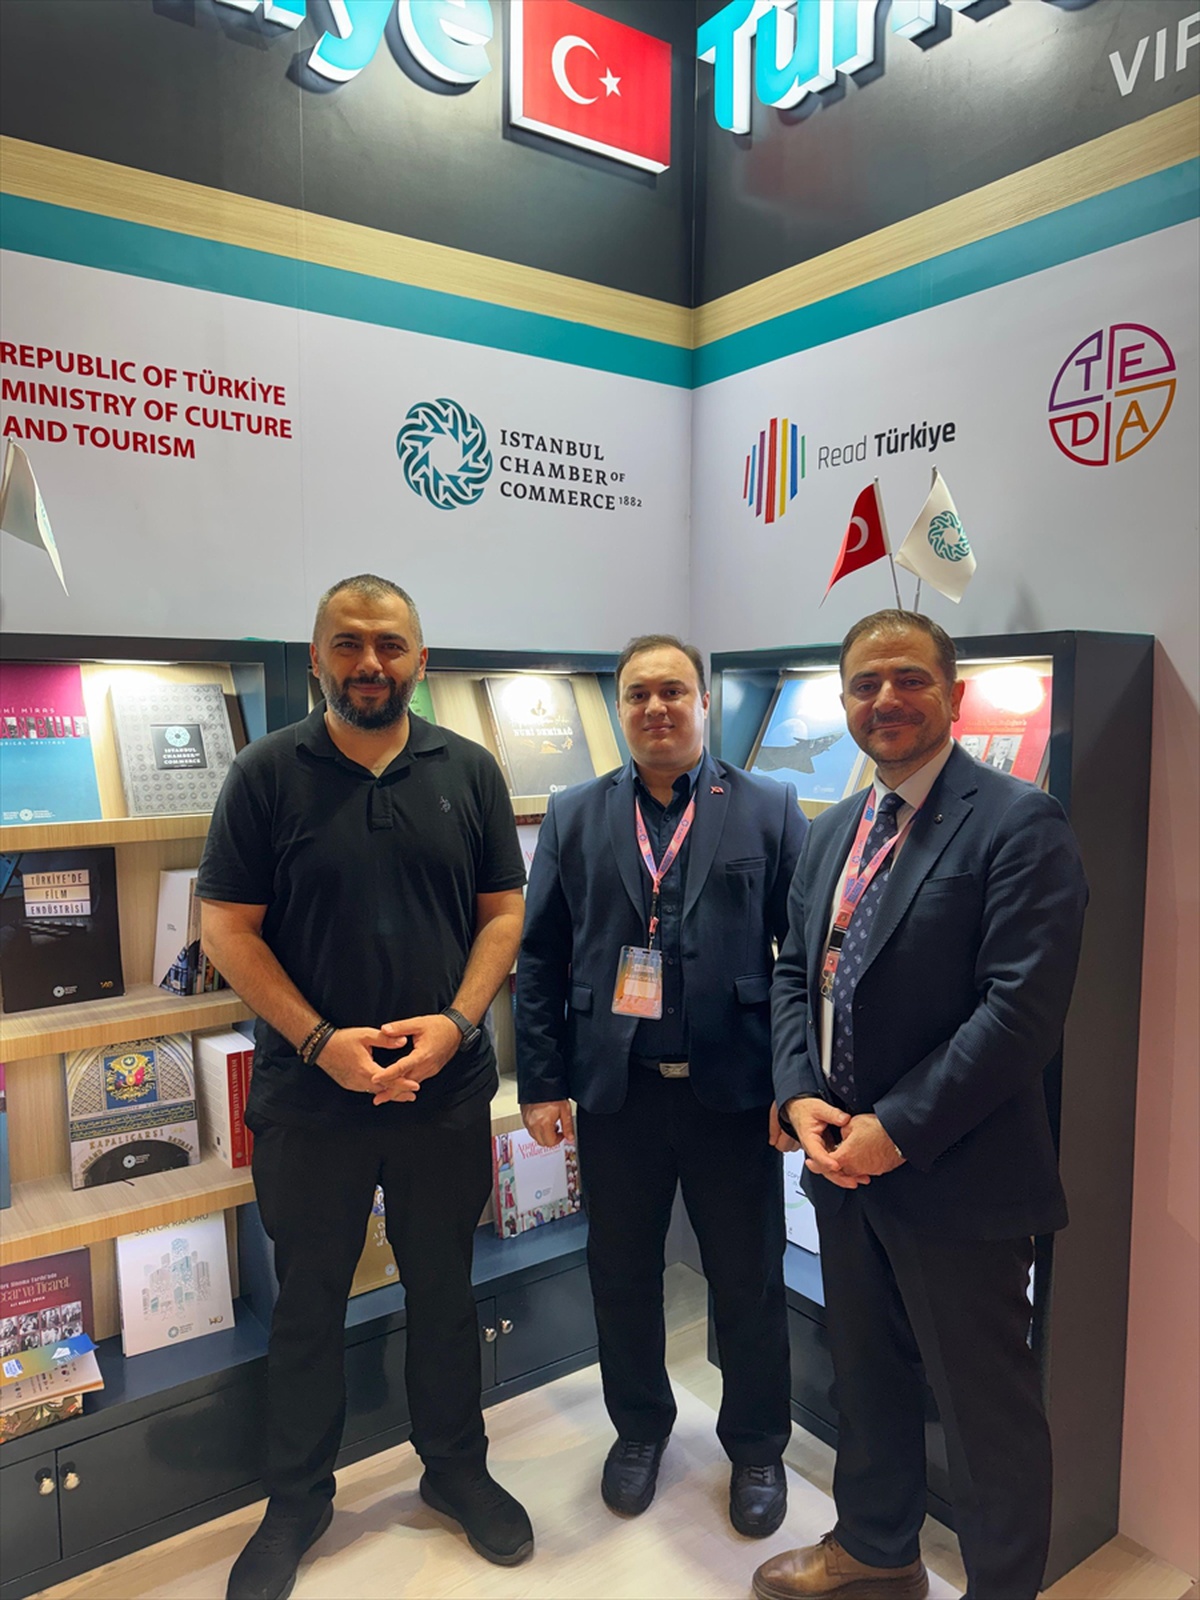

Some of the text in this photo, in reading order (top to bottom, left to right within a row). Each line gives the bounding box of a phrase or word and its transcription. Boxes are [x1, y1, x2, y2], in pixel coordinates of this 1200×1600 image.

[0, 342, 286, 406] REPUBLIC OF TÜRKİYE
[2, 378, 292, 439] MINISTRY OF CULTURE
[3, 415, 196, 459] AND TOURISM
[500, 429, 604, 461] ISTANBUL
[818, 420, 956, 470] Read Türkiye
[500, 455, 626, 486] CHAMBER OF
[500, 481, 643, 510] COMMERCE 1882
[45, 889, 68, 899] FİLM
